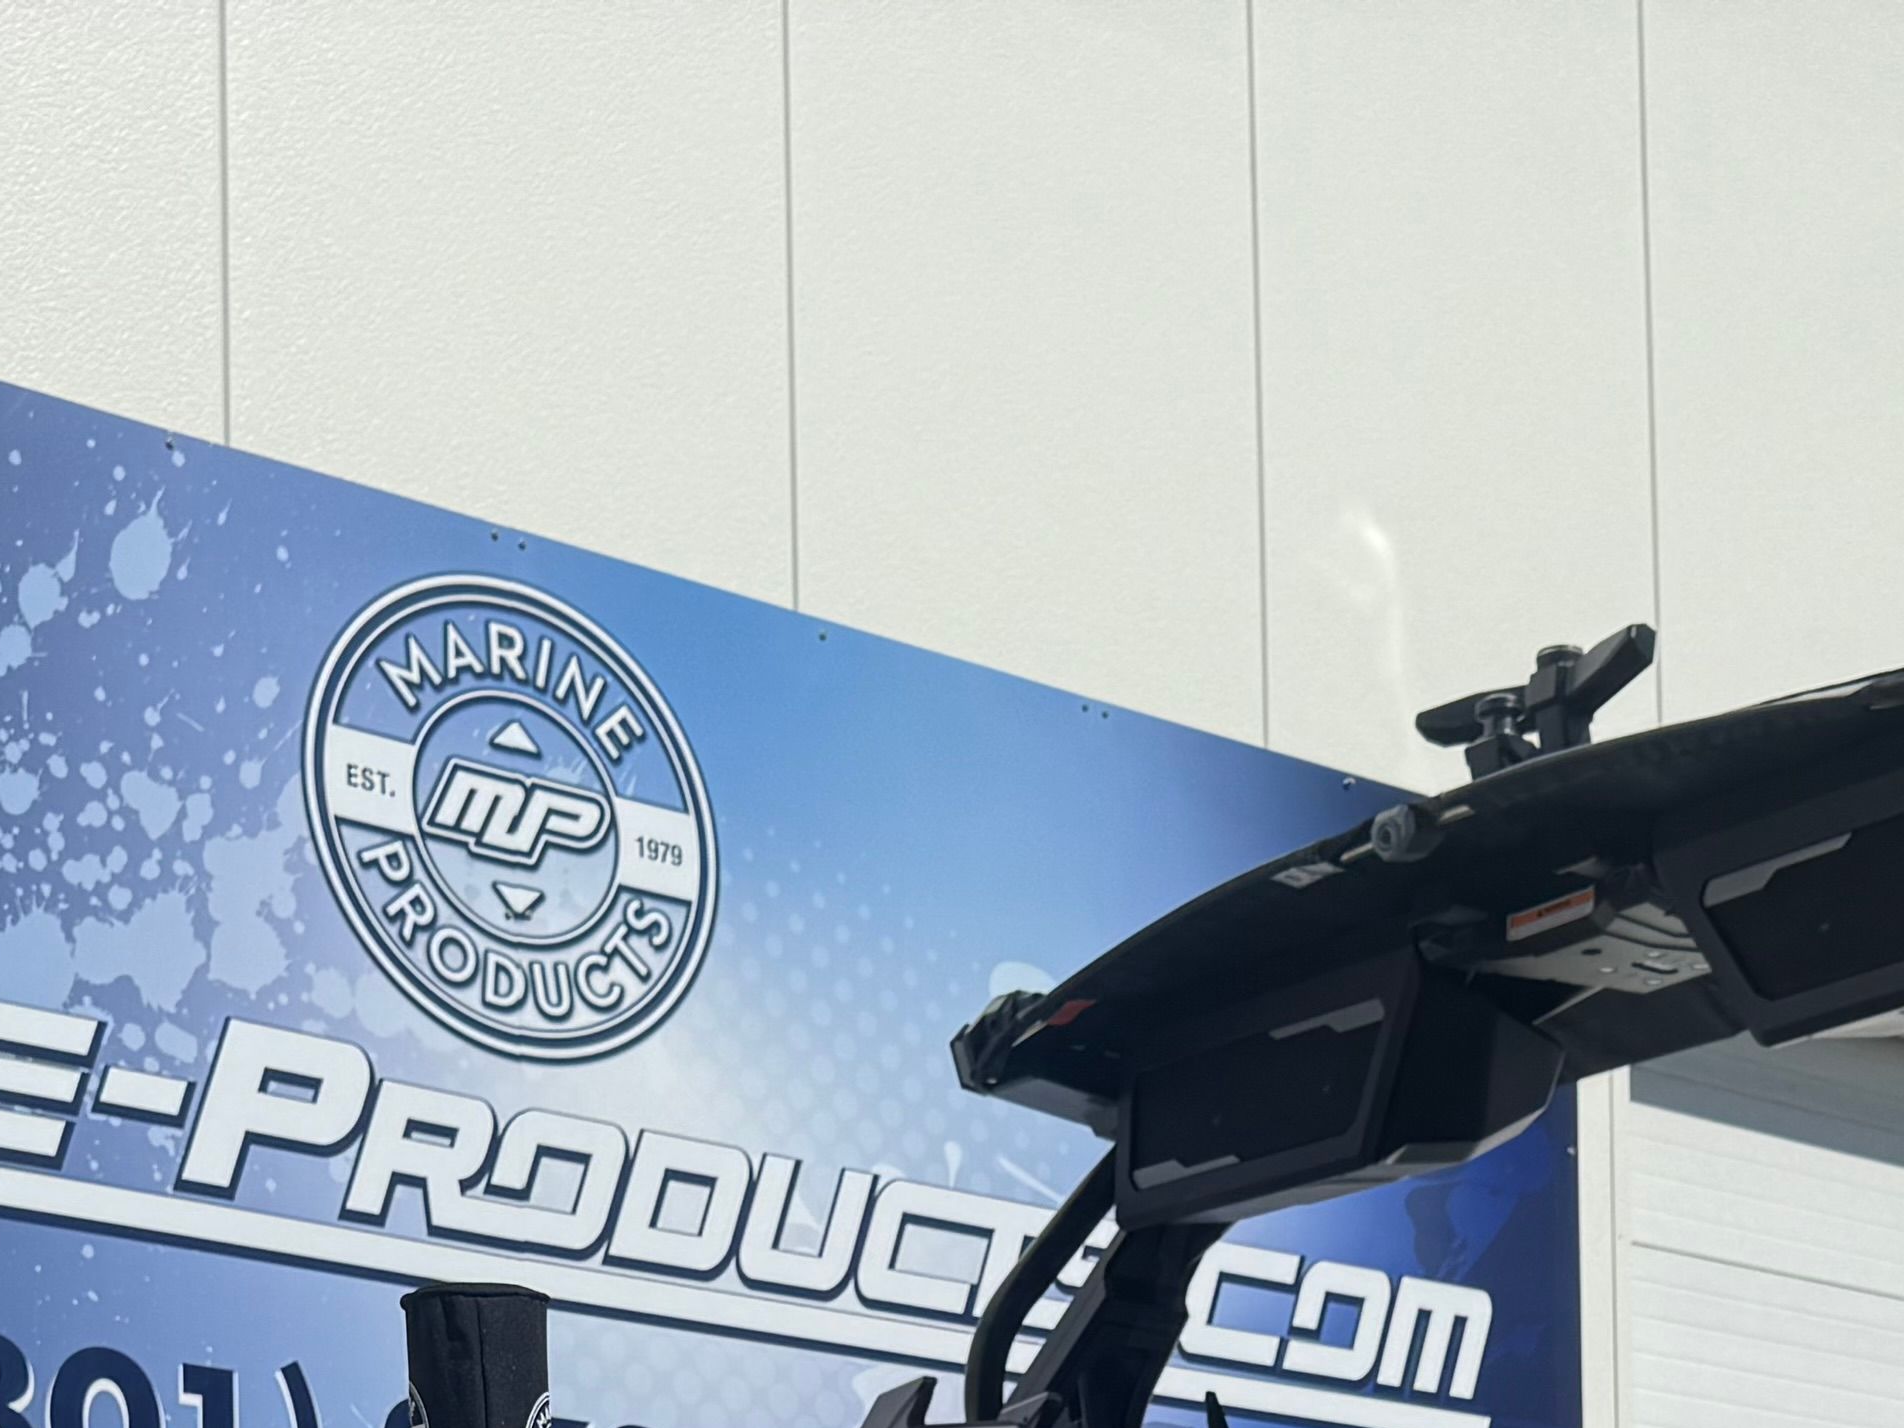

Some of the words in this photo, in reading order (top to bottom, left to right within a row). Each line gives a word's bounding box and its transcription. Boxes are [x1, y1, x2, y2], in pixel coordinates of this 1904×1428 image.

[377, 620, 645, 762] MARINE
[345, 763, 397, 798] EST.
[634, 834, 684, 868] 1979
[359, 838, 674, 1018] PRODUCTS
